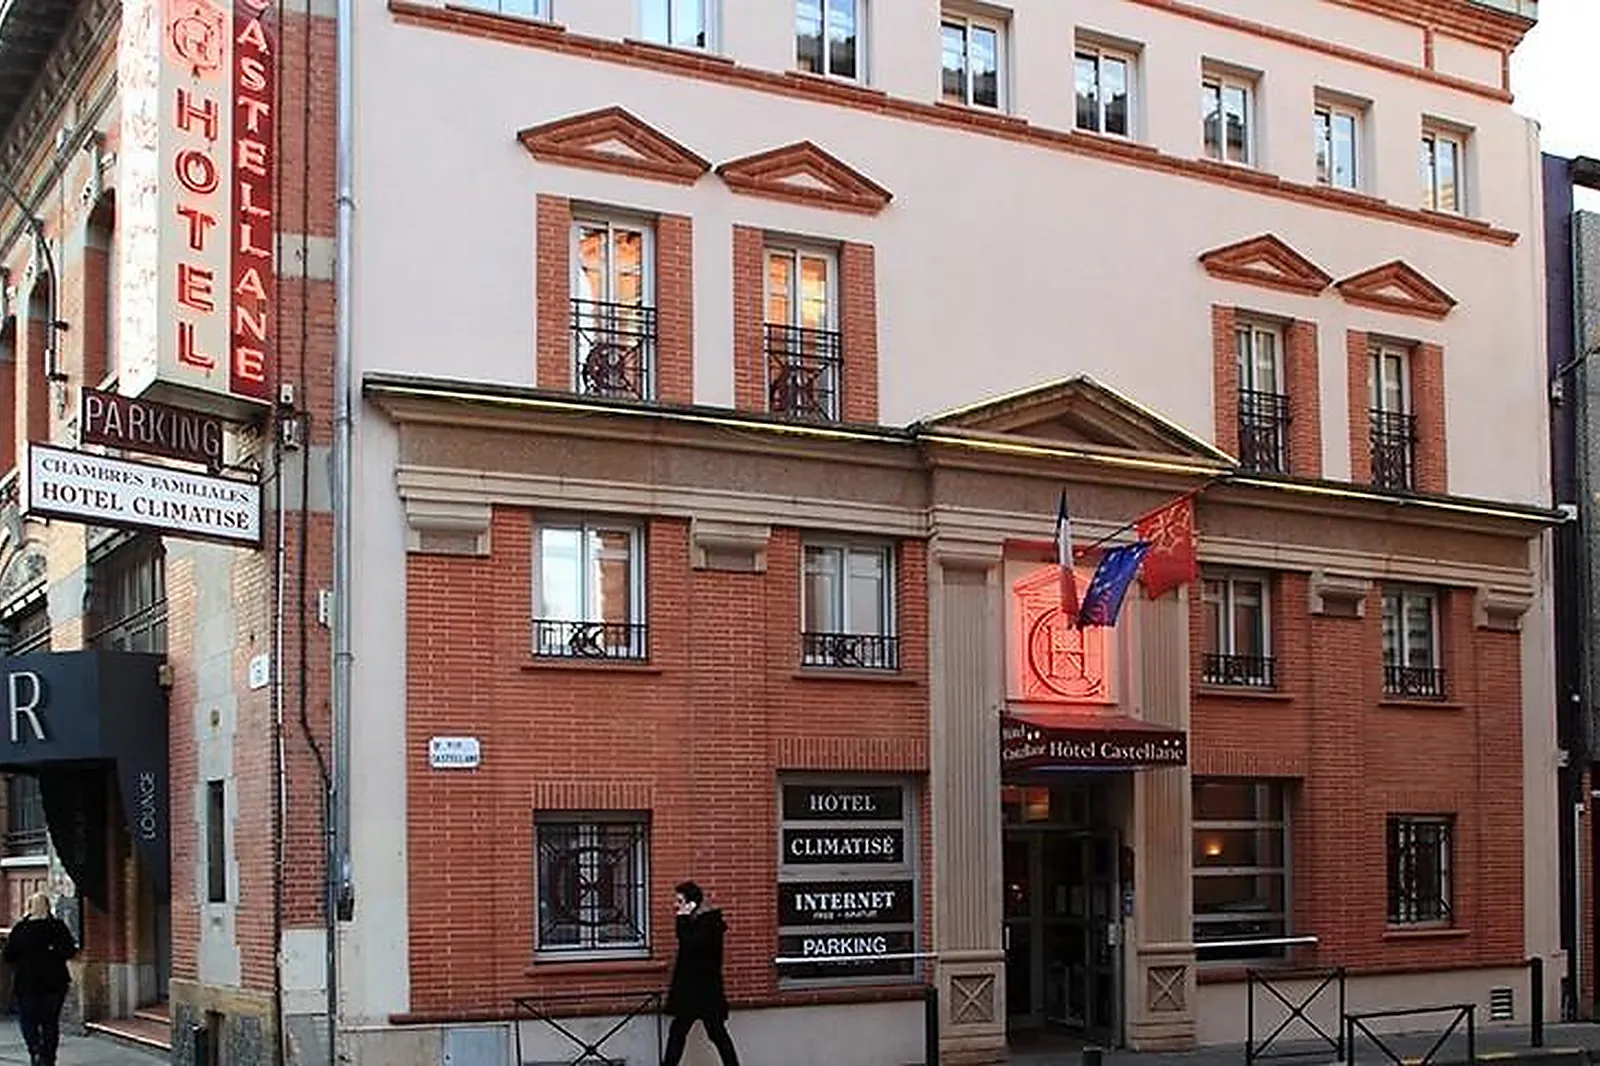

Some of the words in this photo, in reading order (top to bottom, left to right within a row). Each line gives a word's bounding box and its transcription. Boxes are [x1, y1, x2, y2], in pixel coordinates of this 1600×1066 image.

[175, 86, 221, 372] HOTEL
[85, 395, 220, 456] PARKING
[42, 458, 144, 488] CHAMBRES
[151, 475, 249, 503] FAMILIALES
[42, 482, 124, 513] HOTEL
[9, 671, 46, 742] R
[810, 794, 876, 812] HOTEL
[795, 891, 896, 911] INTERNET
[803, 936, 887, 956] PARKING
